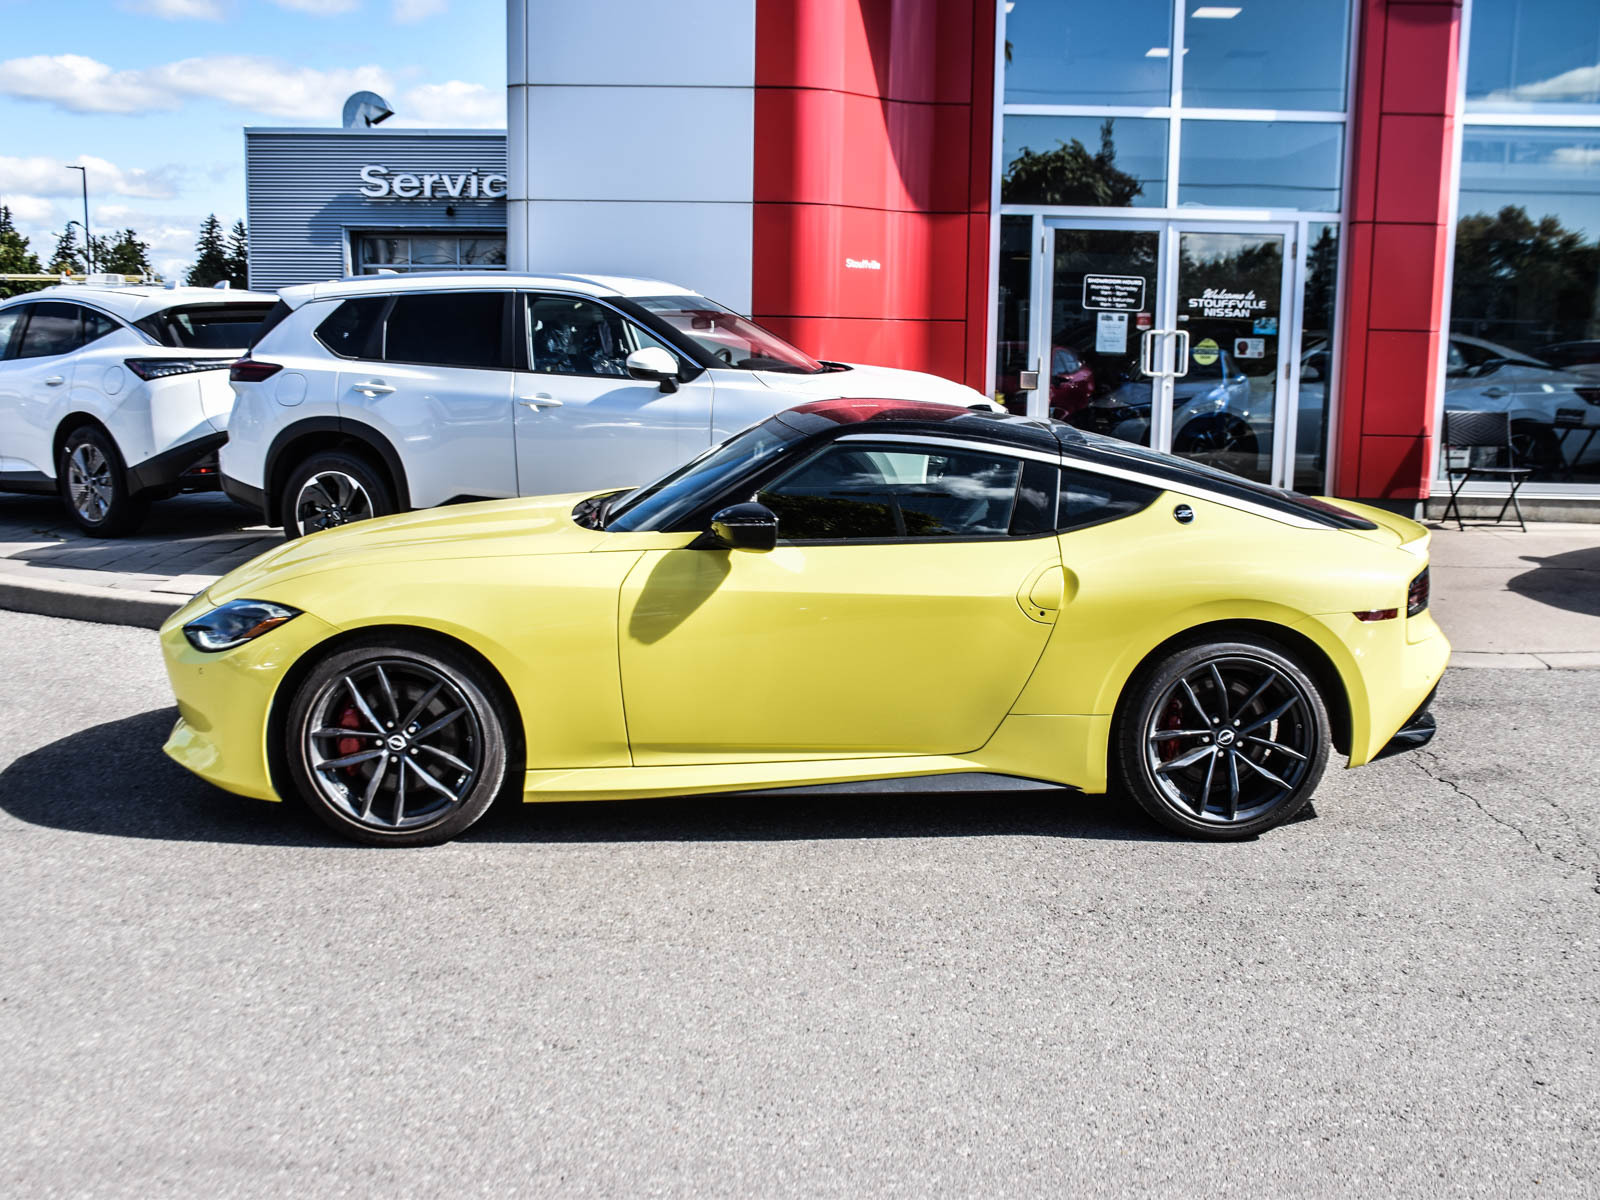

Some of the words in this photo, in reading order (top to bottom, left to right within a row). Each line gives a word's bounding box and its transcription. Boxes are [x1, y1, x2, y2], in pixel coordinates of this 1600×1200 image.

[1202, 288, 1245, 300] Welcome
[1245, 290, 1256, 300] to
[1188, 298, 1267, 309] STOUFFVILLE
[1203, 307, 1250, 318] NISSAN
